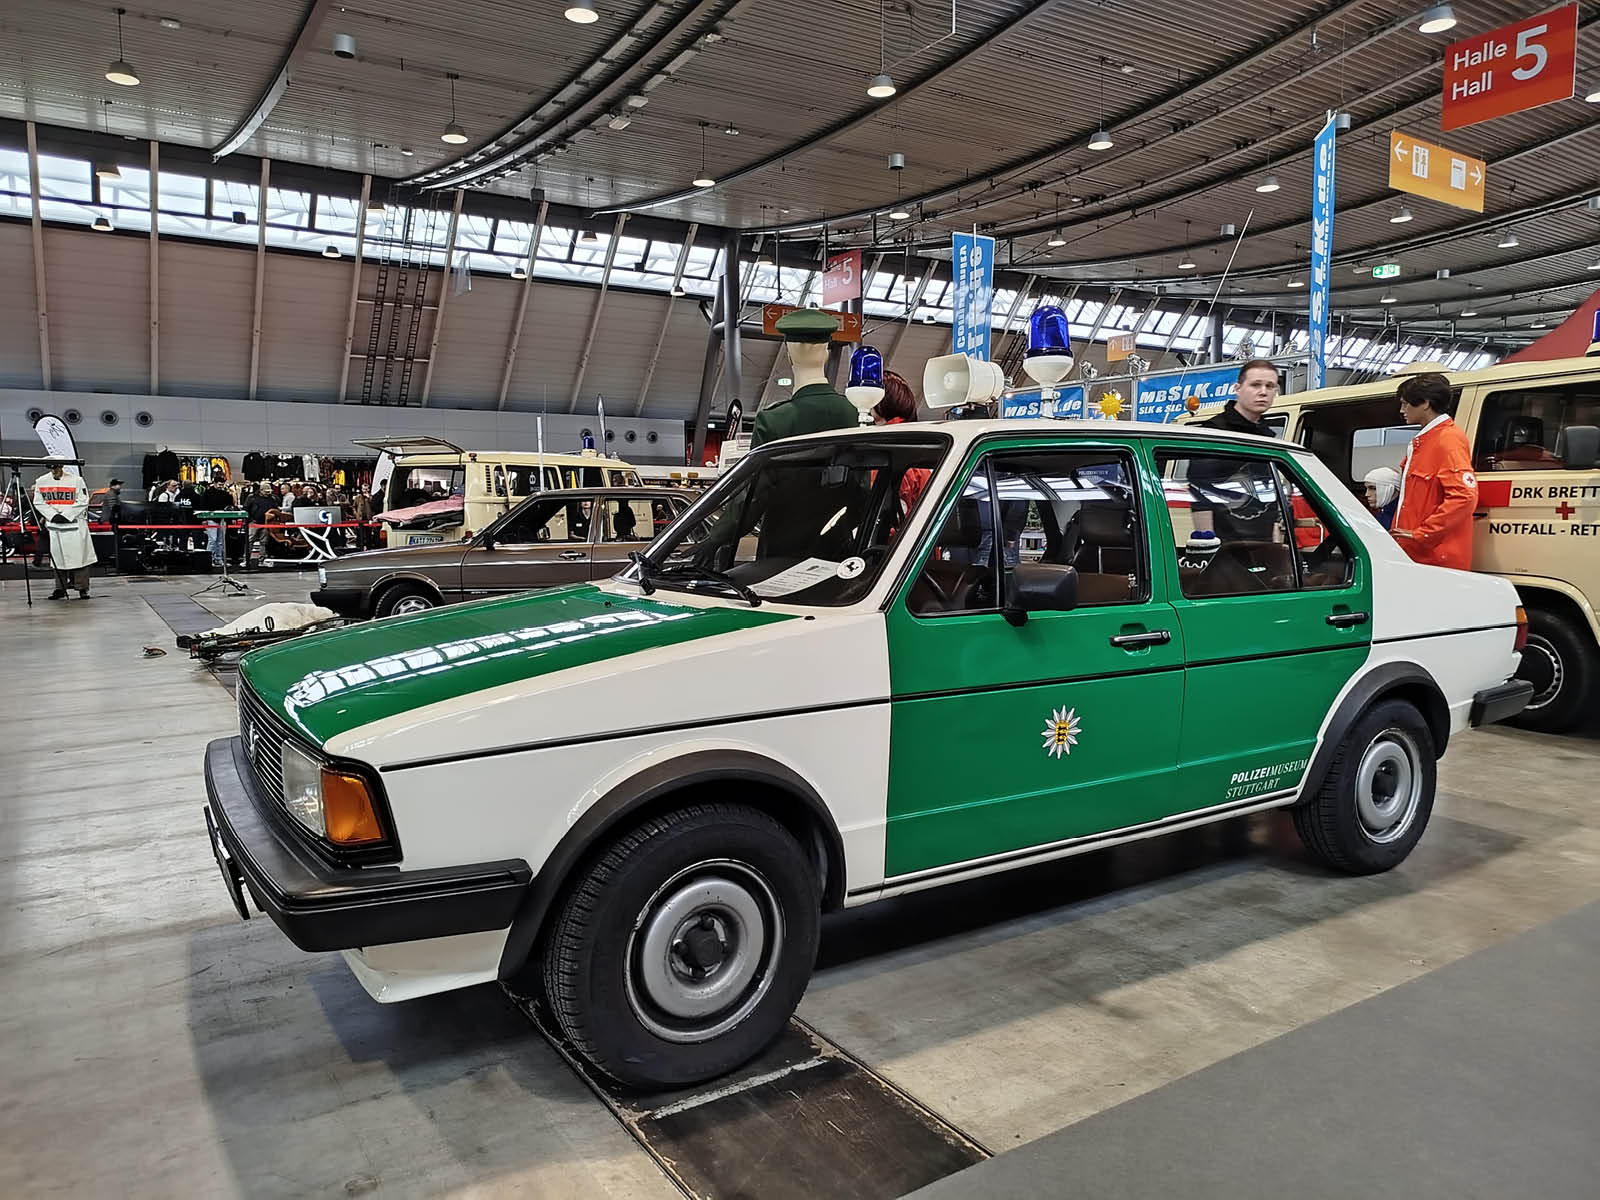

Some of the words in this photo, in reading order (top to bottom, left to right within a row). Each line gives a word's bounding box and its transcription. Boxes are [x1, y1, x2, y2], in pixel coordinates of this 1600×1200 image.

[1453, 40, 1507, 71] Halle
[1511, 24, 1548, 81] 5
[1451, 70, 1493, 100] Hall
[842, 257, 853, 285] 5
[1138, 405, 1154, 415] SLK
[42, 491, 74, 501] POLIZEI
[1512, 487, 1544, 499] DRK
[1548, 486, 1600, 499] BRETT
[1489, 523, 1556, 536] NOTFALL
[1570, 524, 1600, 536] RET
[1225, 778, 1281, 799] STUTTGART
